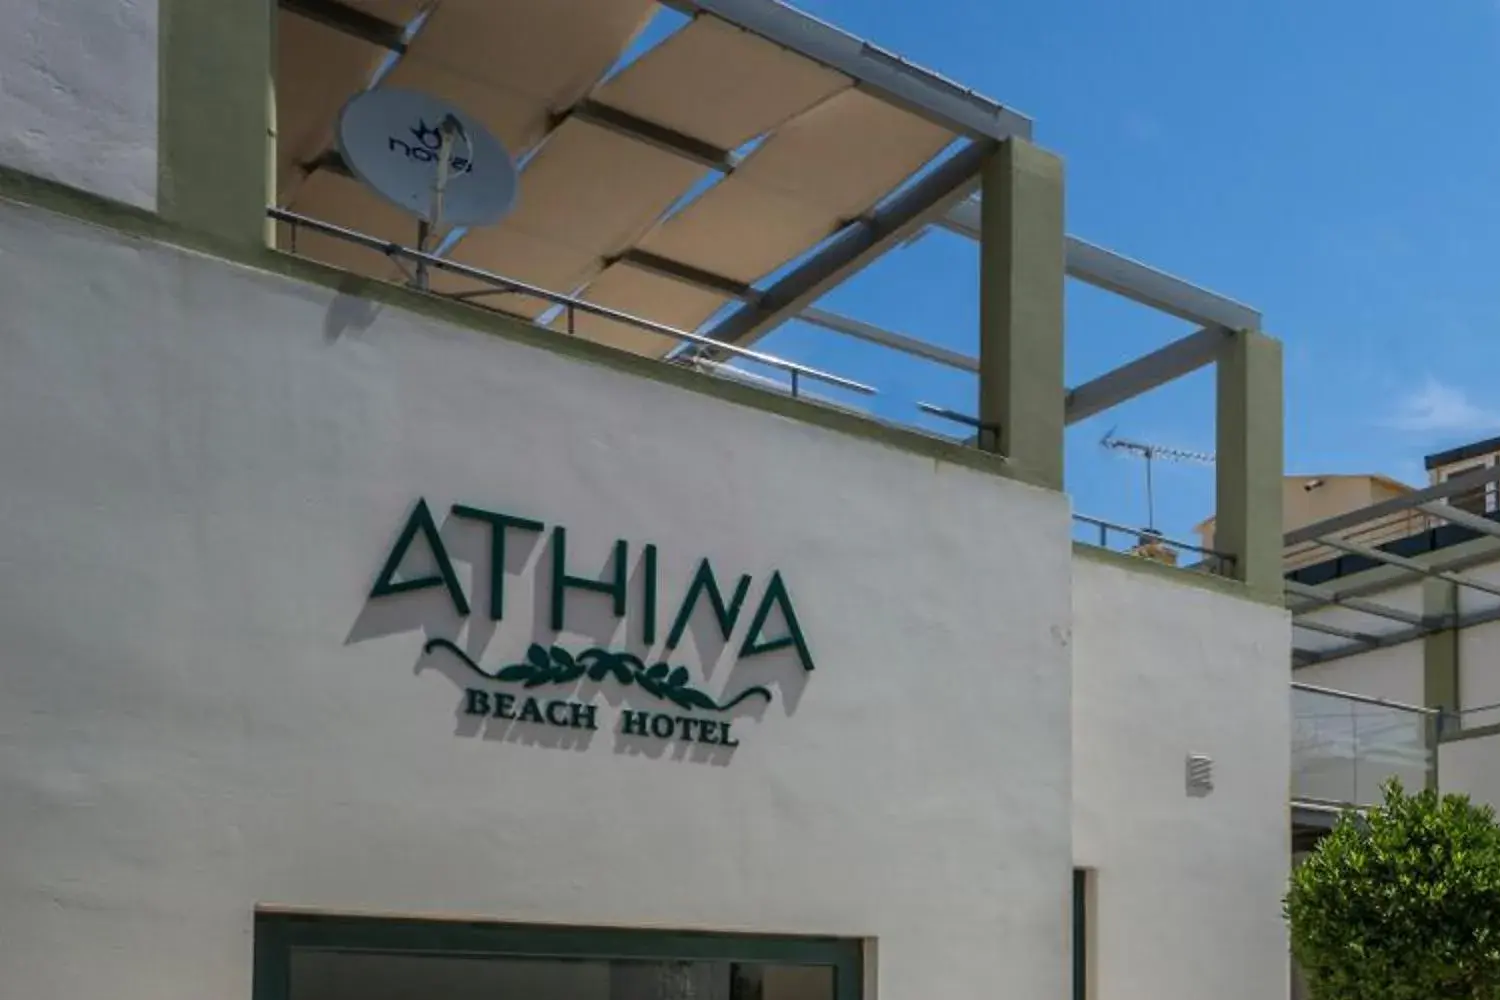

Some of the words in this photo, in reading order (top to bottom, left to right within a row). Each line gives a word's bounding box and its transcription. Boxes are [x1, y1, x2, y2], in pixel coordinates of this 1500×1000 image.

[369, 496, 815, 671] ATHINA
[464, 687, 598, 730] BEACH
[621, 709, 739, 747] HOTEL
